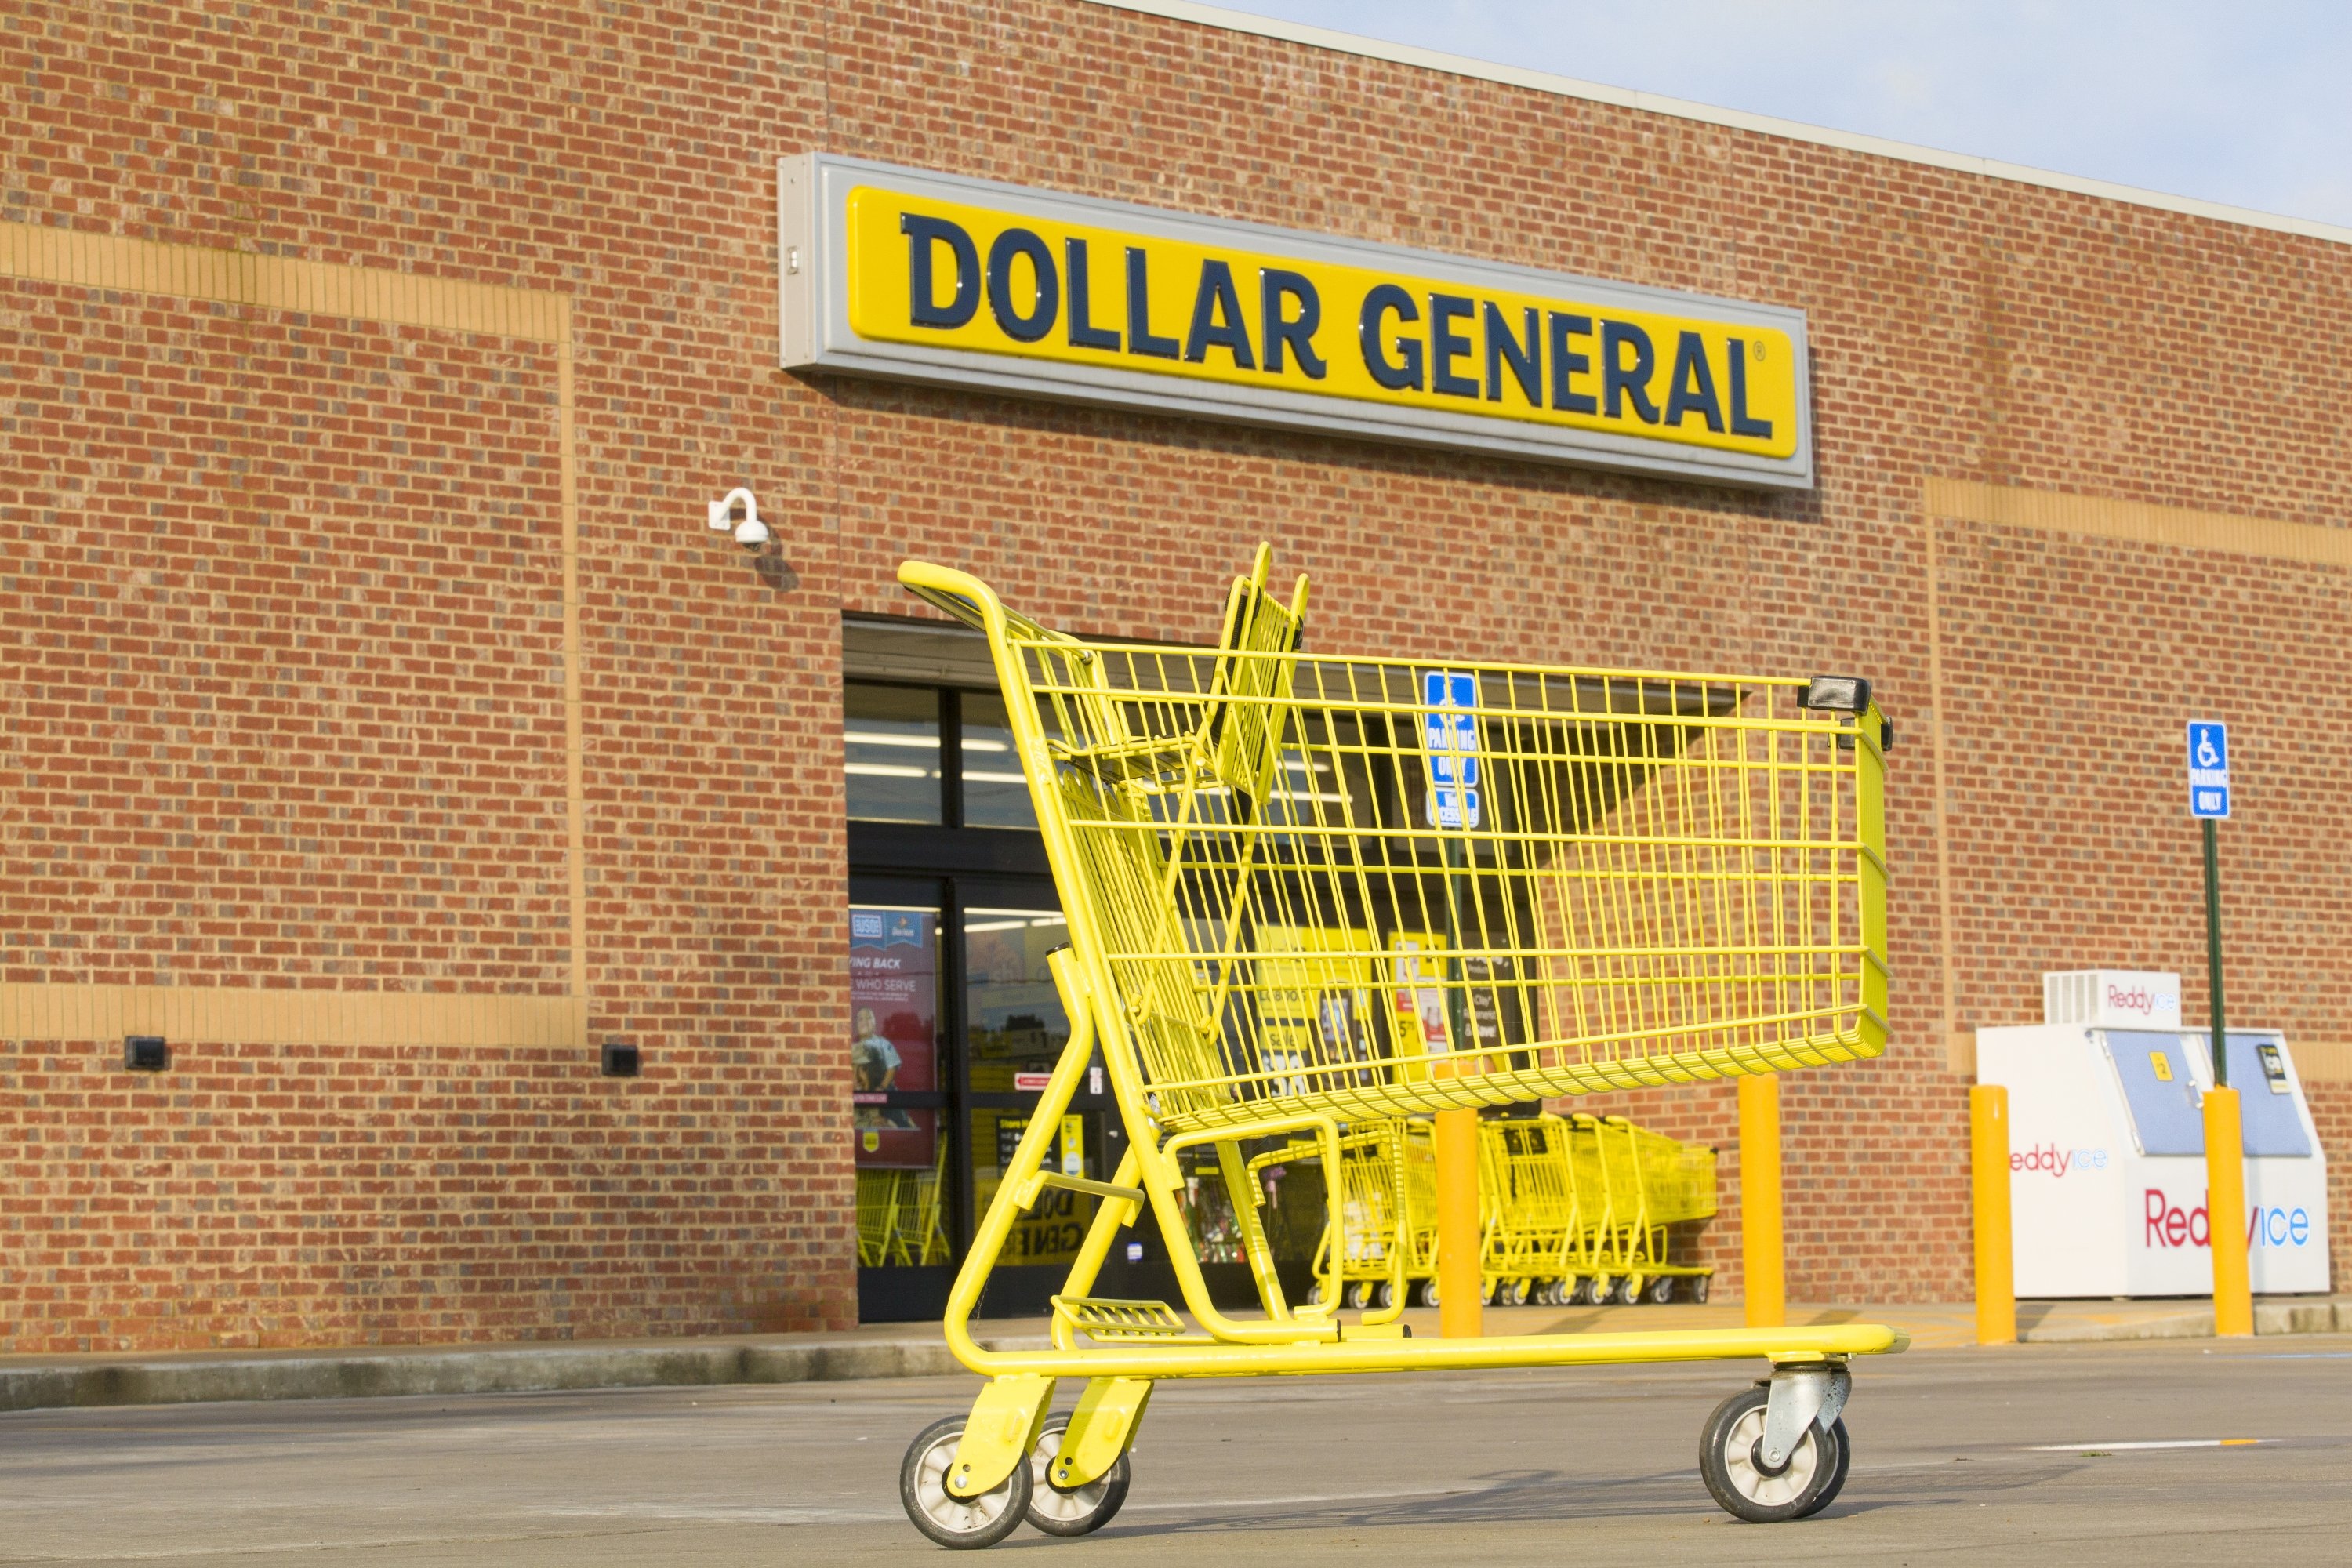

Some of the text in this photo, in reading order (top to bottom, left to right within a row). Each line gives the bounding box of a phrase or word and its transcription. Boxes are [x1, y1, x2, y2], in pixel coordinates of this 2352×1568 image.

[900, 211, 1773, 441] DOLLAR GENERAL
[1428, 727, 1475, 750] PARING
[1438, 755, 1467, 778] ONY
[873, 957, 902, 970] BACK
[855, 978, 882, 991] WHO
[884, 979, 916, 993] SERVE
[2009, 1142, 2072, 1178] eddy
[2145, 1188, 2259, 1256] Red
